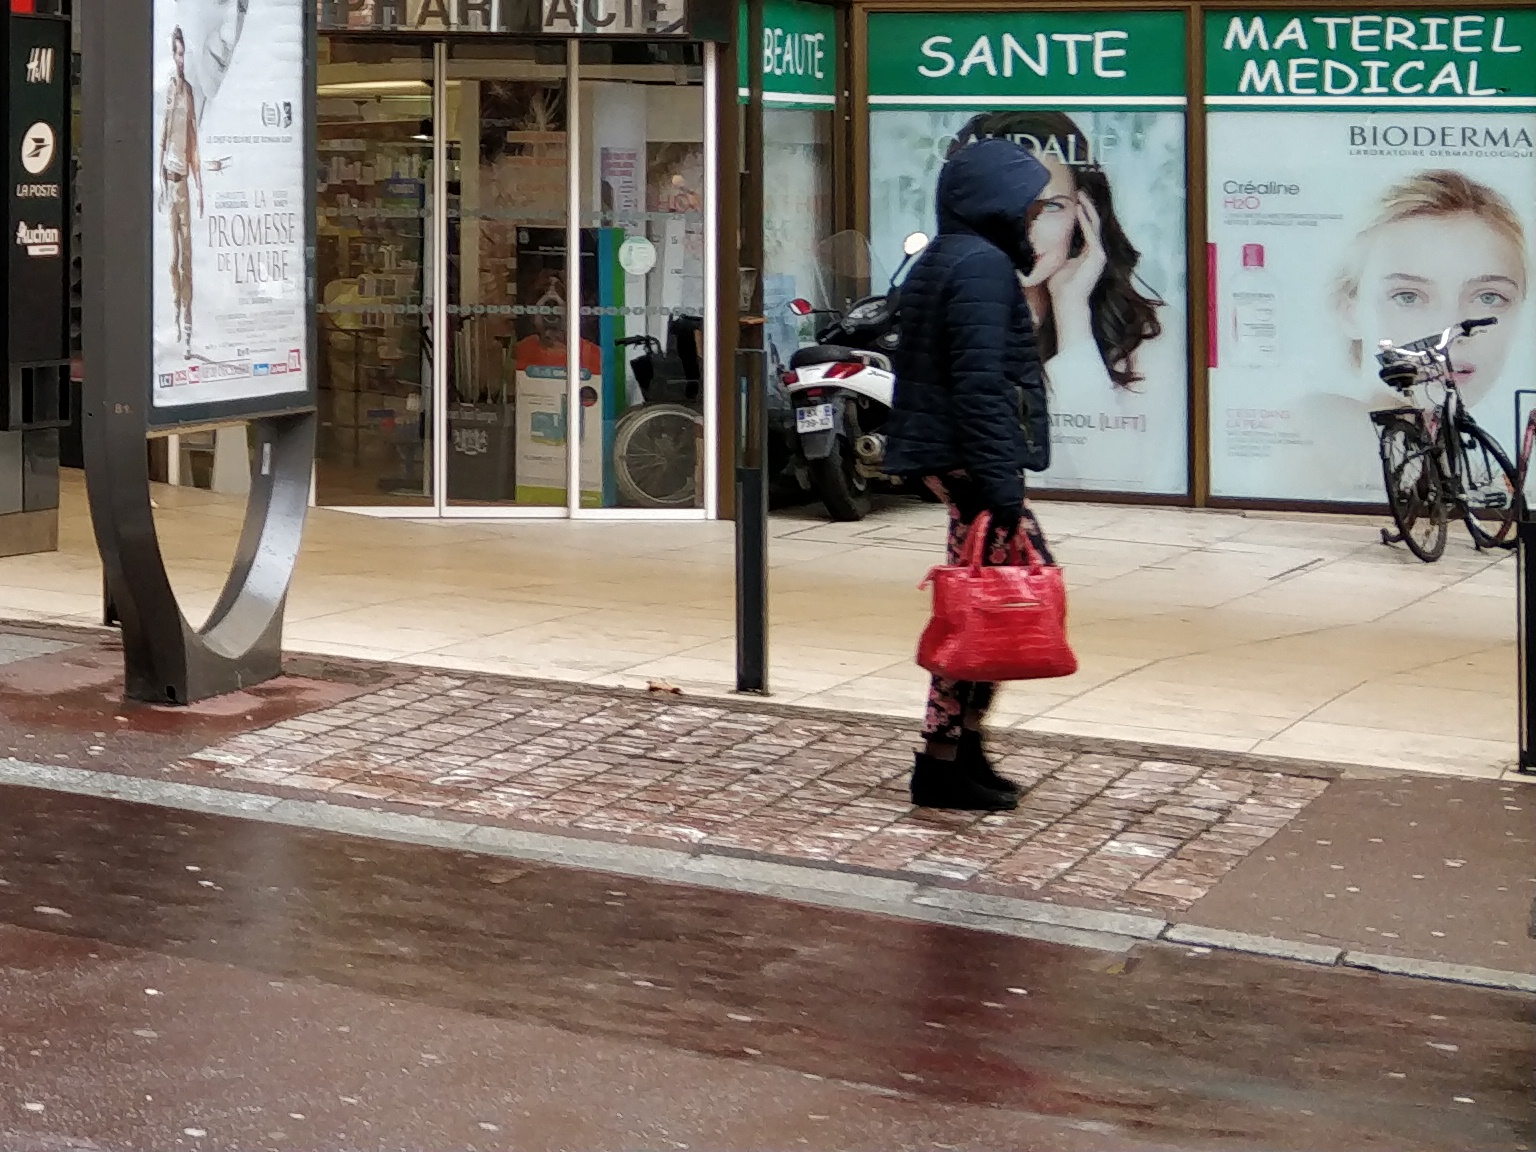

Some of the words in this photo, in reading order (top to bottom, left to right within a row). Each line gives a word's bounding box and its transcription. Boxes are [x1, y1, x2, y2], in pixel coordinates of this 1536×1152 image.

[1223, 15, 1523, 54] MATERIEL
[26, 47, 54, 84] H&M
[763, 27, 825, 80] BEAUTE
[917, 30, 1128, 79] SANTE
[1238, 57, 1498, 97] MEDICAL
[1349, 125, 1534, 149] BIODERMA
[16, 183, 28, 197] LA
[30, 184, 59, 198] POSTE
[1223, 180, 1300, 196] Créaline
[16, 220, 59, 245] Auchan
[208, 212, 295, 248] PROMESSE
[217, 252, 231, 272] DE
[234, 250, 289, 284] L'AUBE
